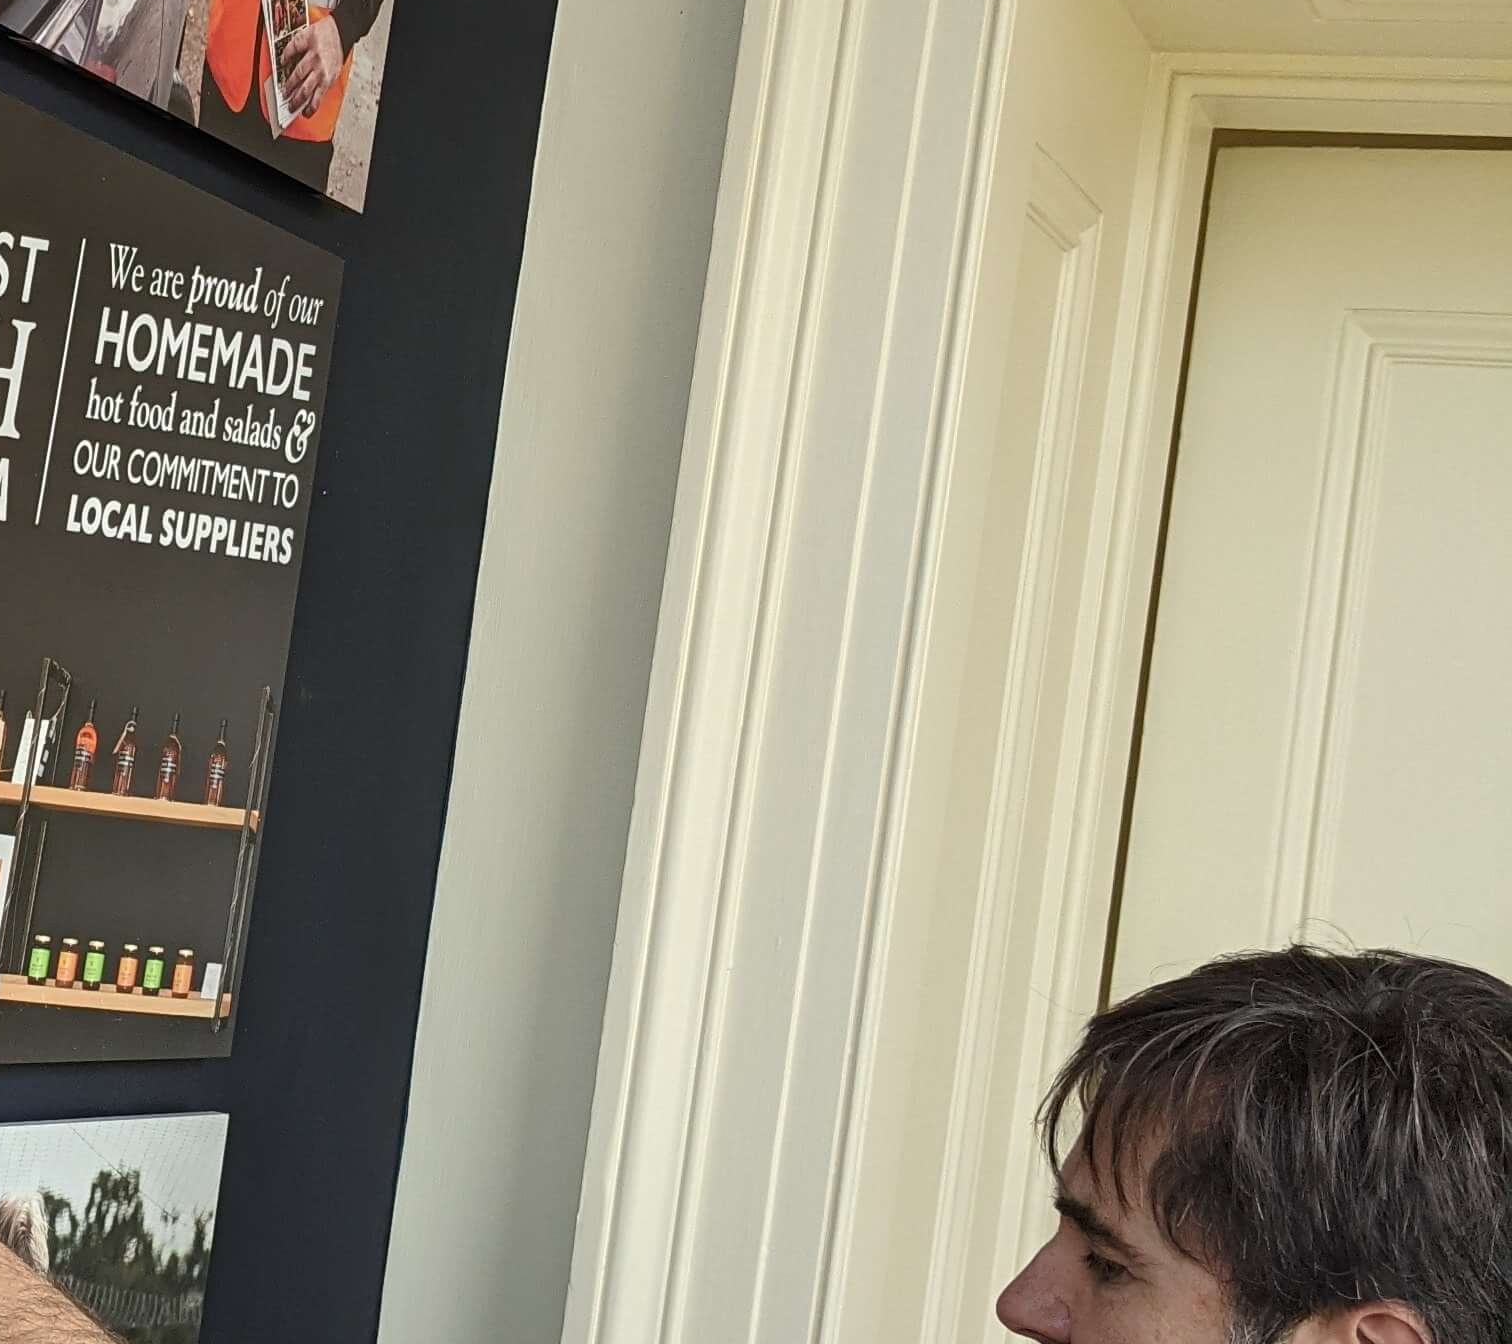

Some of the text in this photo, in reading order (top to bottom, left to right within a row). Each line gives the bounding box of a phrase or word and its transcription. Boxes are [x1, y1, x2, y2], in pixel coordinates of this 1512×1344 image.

[109, 243, 324, 329] We are proud of our
[94, 306, 317, 401] HOMEMADE
[85, 376, 316, 463] hot food and salads &
[73, 439, 299, 509] OUR COMMITMENT TO
[66, 494, 294, 565] LOCAL SUPPLIERS
